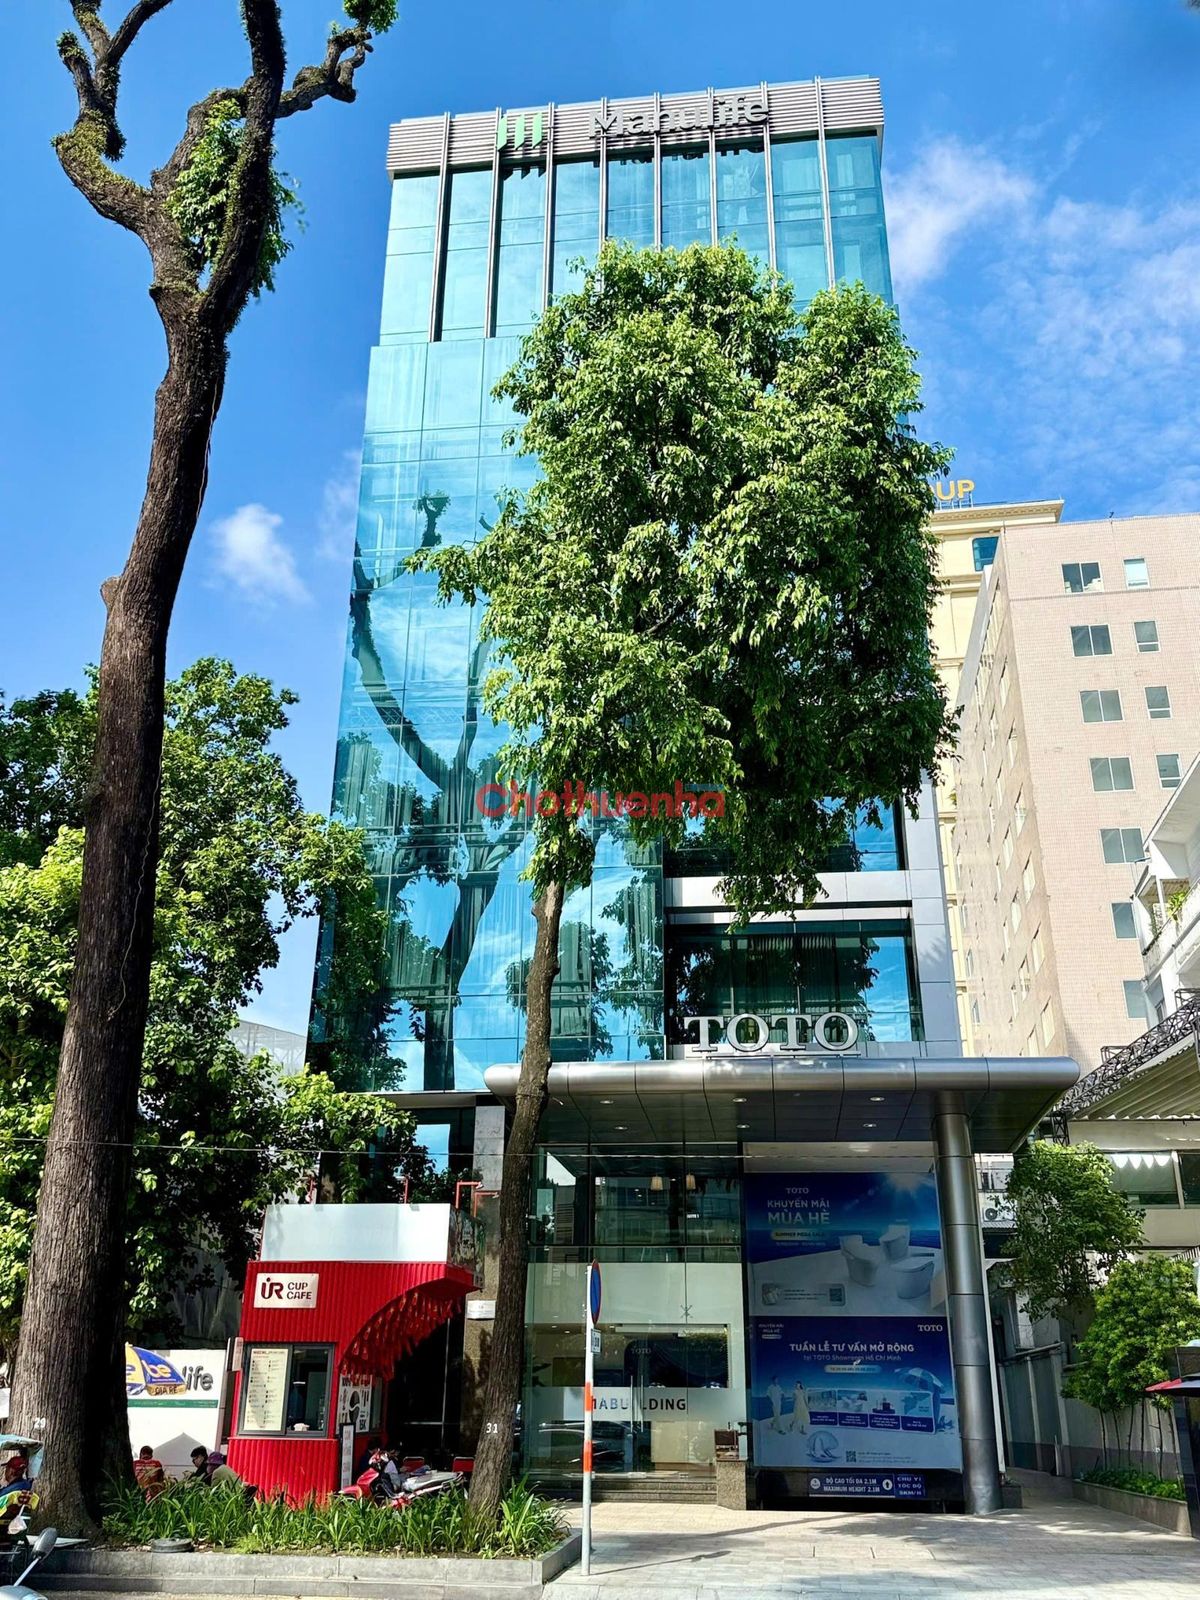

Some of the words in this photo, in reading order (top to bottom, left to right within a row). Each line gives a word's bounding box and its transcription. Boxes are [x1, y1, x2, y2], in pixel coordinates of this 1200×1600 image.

[588, 94, 769, 138] Manulife
[930, 479, 975, 501] UP
[683, 1012, 858, 1052] TOTO
[785, 1187, 810, 1195] TOTO
[768, 1209, 805, 1225] MÙA
[808, 1209, 830, 1225] HÈ
[287, 1282, 309, 1291] CUP
[286, 1291, 312, 1300] CAFE
[917, 1324, 943, 1332] TOTO
[141, 1359, 172, 1379] be
[486, 1422, 499, 1434] 31
